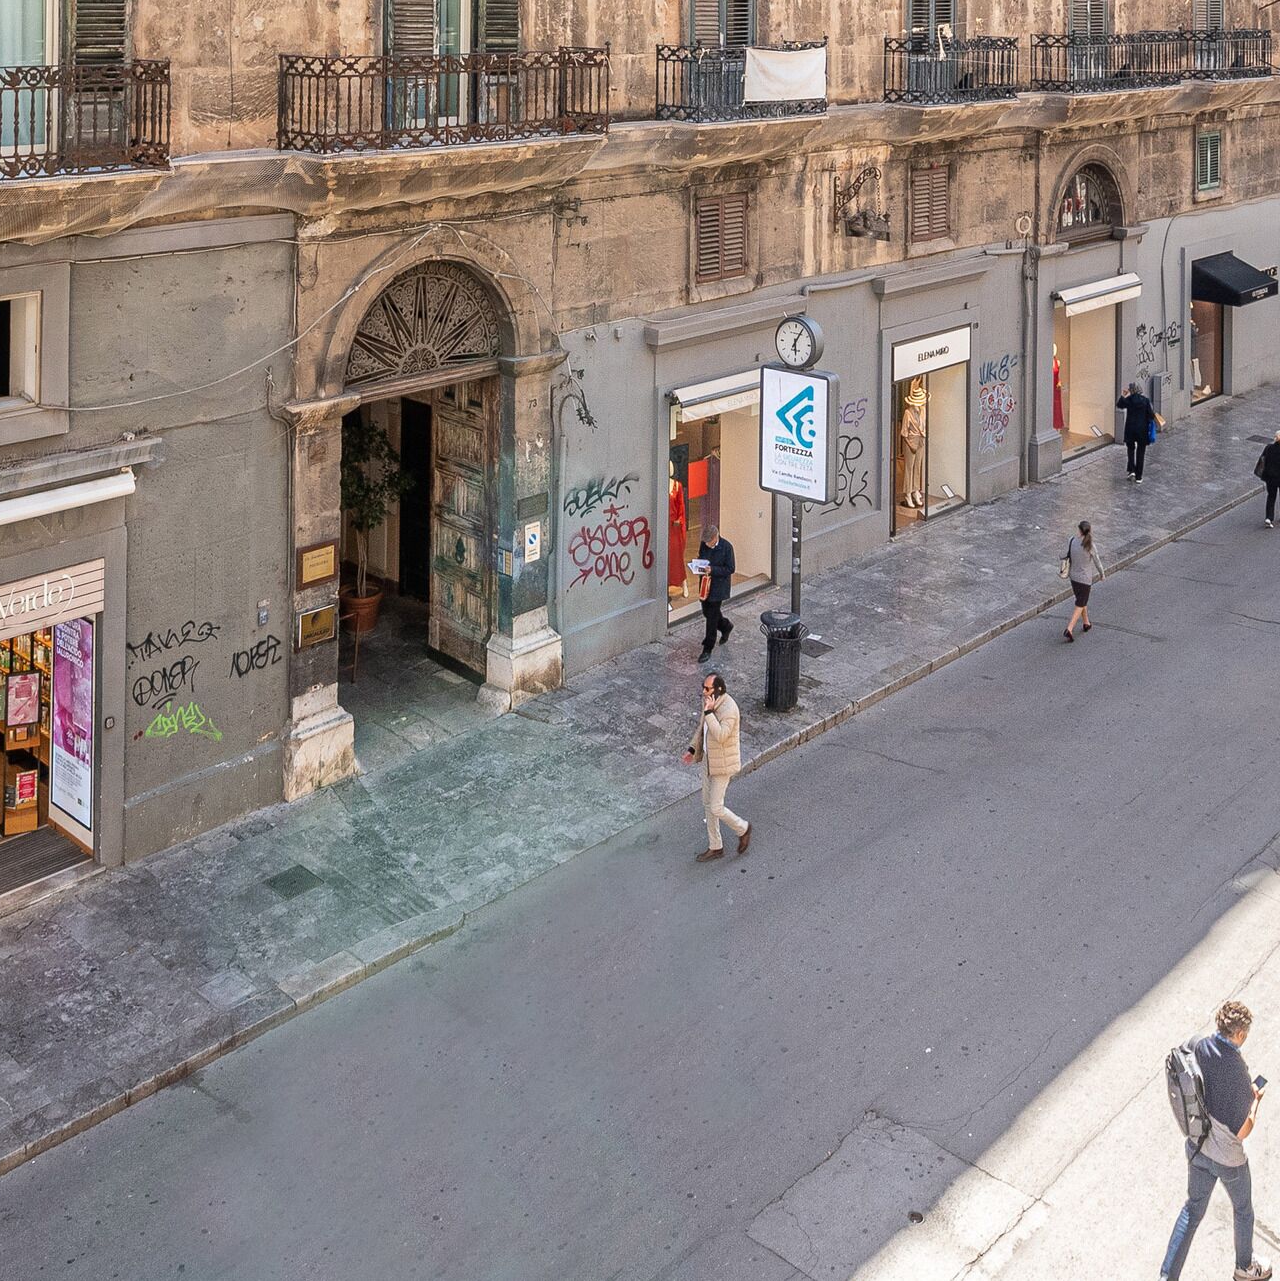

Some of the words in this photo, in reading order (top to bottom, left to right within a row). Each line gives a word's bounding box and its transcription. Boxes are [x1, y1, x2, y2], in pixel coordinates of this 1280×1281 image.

[917, 349, 935, 363] ELENA
[528, 398, 538, 409] 73
[775, 444, 813, 457] FORTEZZZA
